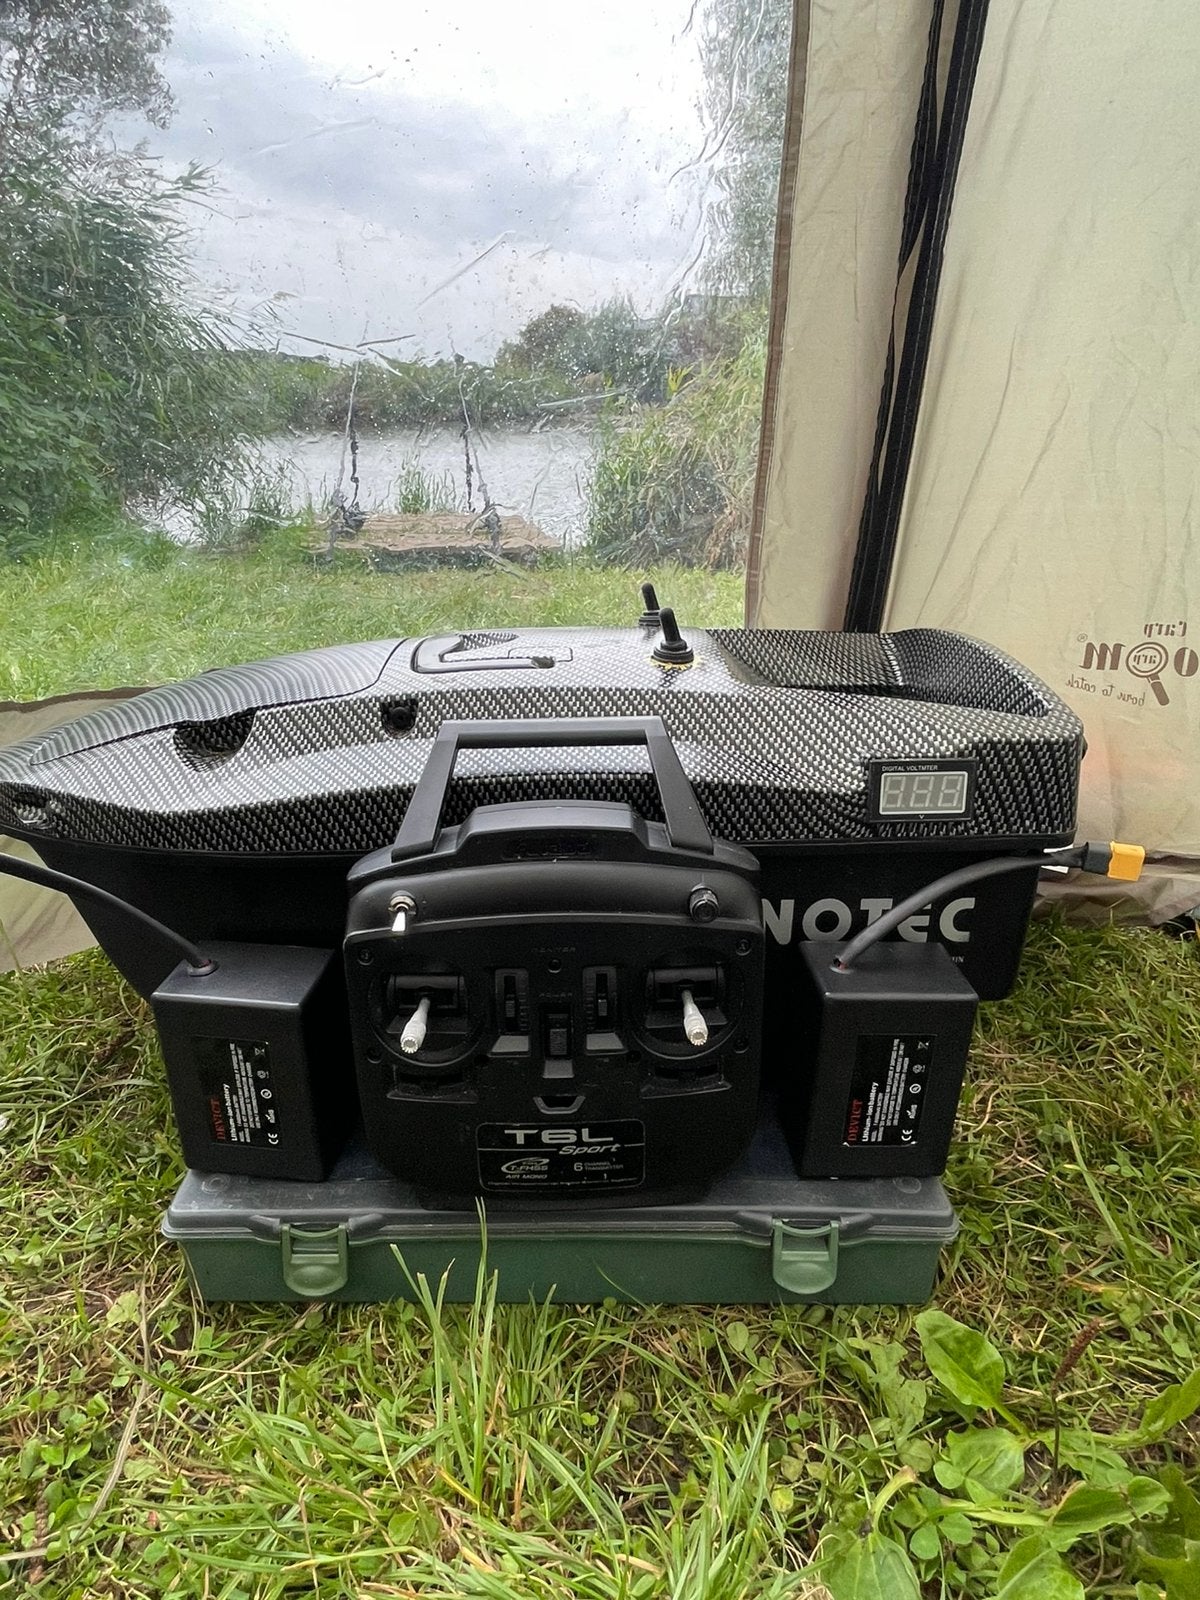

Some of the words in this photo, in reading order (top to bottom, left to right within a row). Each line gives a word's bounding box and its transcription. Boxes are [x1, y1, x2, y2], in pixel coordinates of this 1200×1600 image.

[868, 1082, 879, 1106] battery
[504, 1128, 614, 1145] T6L
[558, 1143, 622, 1156] Sport
[574, 1162, 583, 1171] 6
